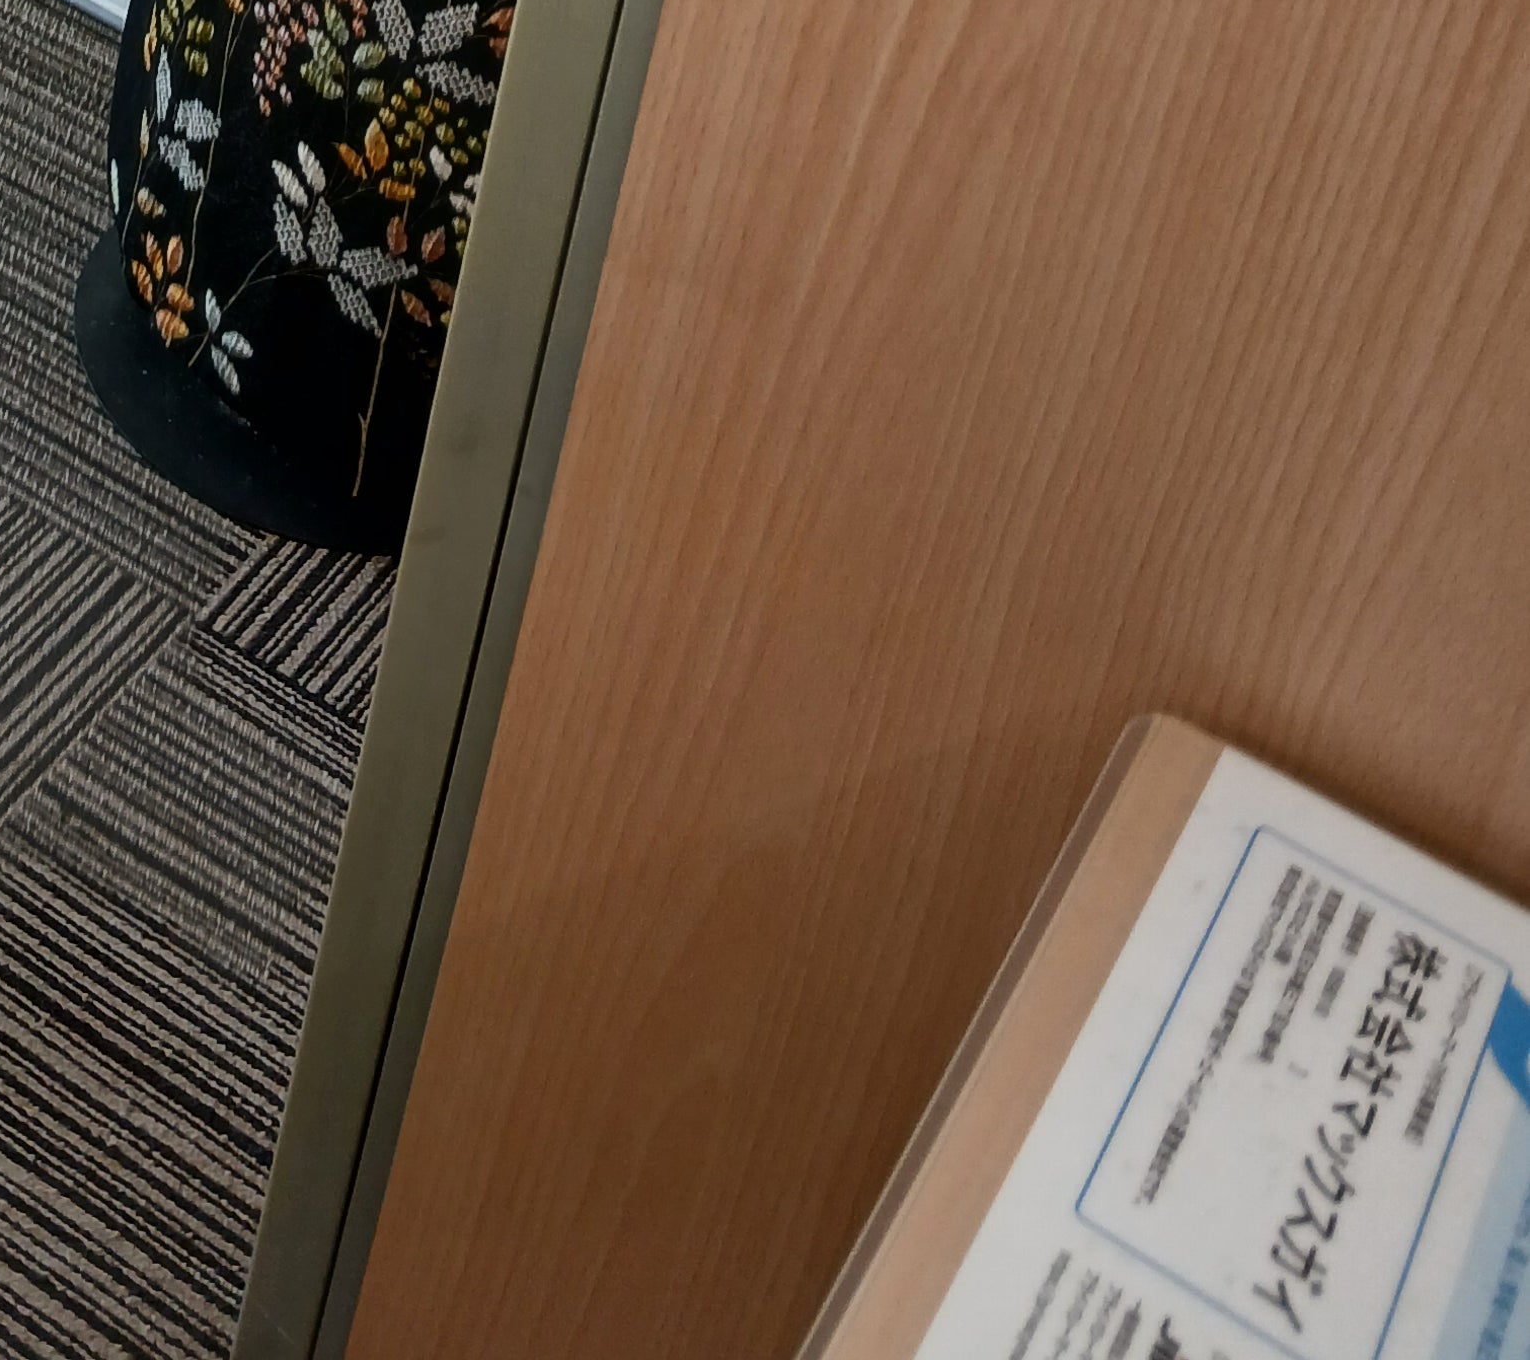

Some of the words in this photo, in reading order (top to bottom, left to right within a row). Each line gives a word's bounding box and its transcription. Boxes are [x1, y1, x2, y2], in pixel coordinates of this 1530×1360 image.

[1252, 930, 1448, 1334] 株式会社マックスガイ
